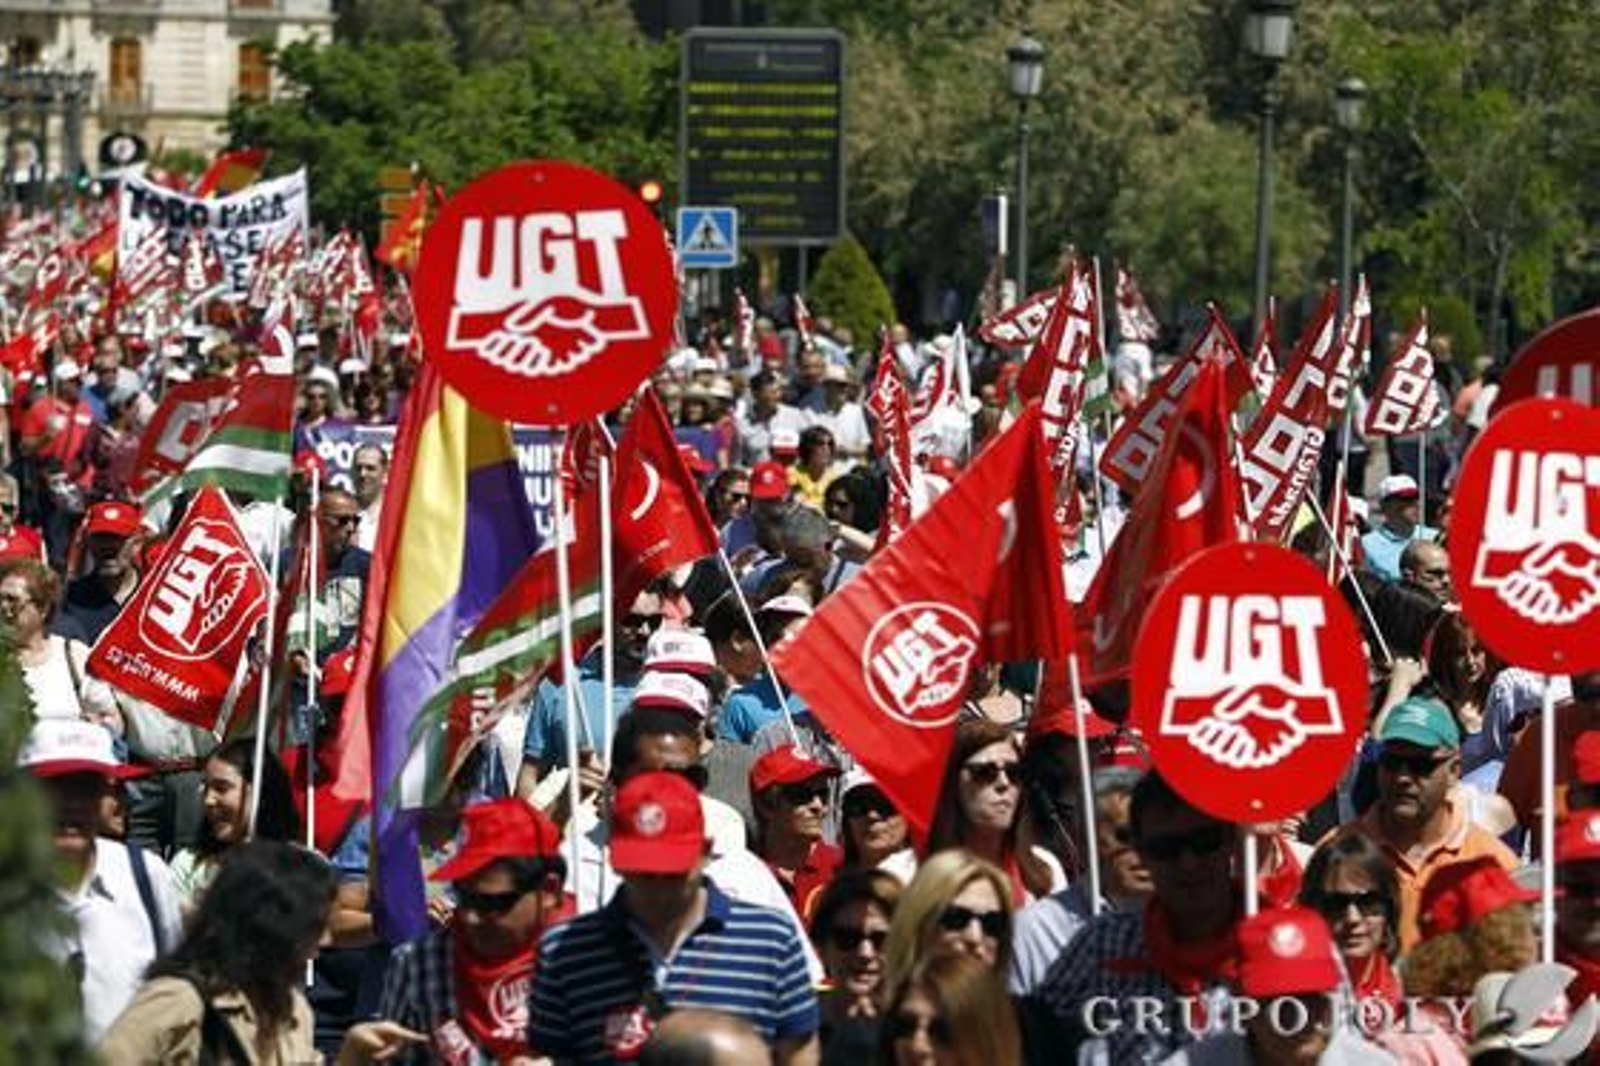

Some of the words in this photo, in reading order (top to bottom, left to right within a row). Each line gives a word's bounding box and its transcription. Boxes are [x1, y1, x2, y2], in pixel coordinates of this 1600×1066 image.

[126, 183, 208, 227] TODO
[221, 193, 288, 228] PARA
[455, 209, 628, 314] UGT
[147, 526, 240, 638] UGT
[872, 609, 962, 700] UGT
[1170, 594, 1326, 697] UGT
